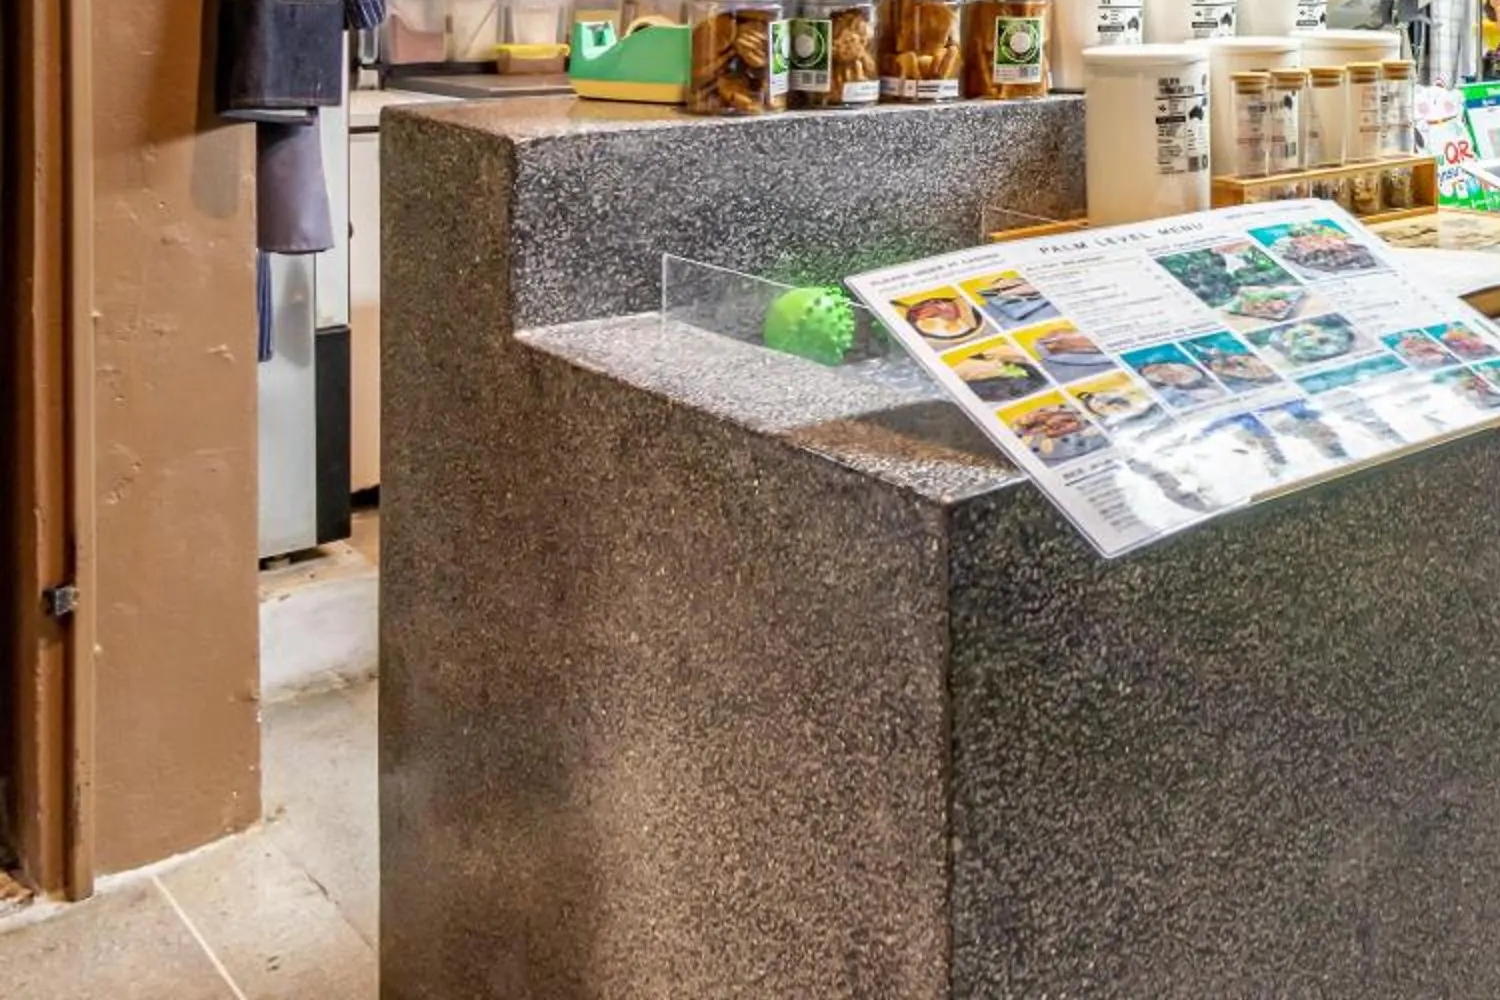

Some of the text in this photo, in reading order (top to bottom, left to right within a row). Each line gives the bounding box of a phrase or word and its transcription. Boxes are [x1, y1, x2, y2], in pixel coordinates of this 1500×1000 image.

[1444, 140, 1474, 165] QR
[1038, 240, 1089, 255] PALM
[1094, 231, 1152, 248] LEVEL
[1156, 222, 1204, 237] MENU
